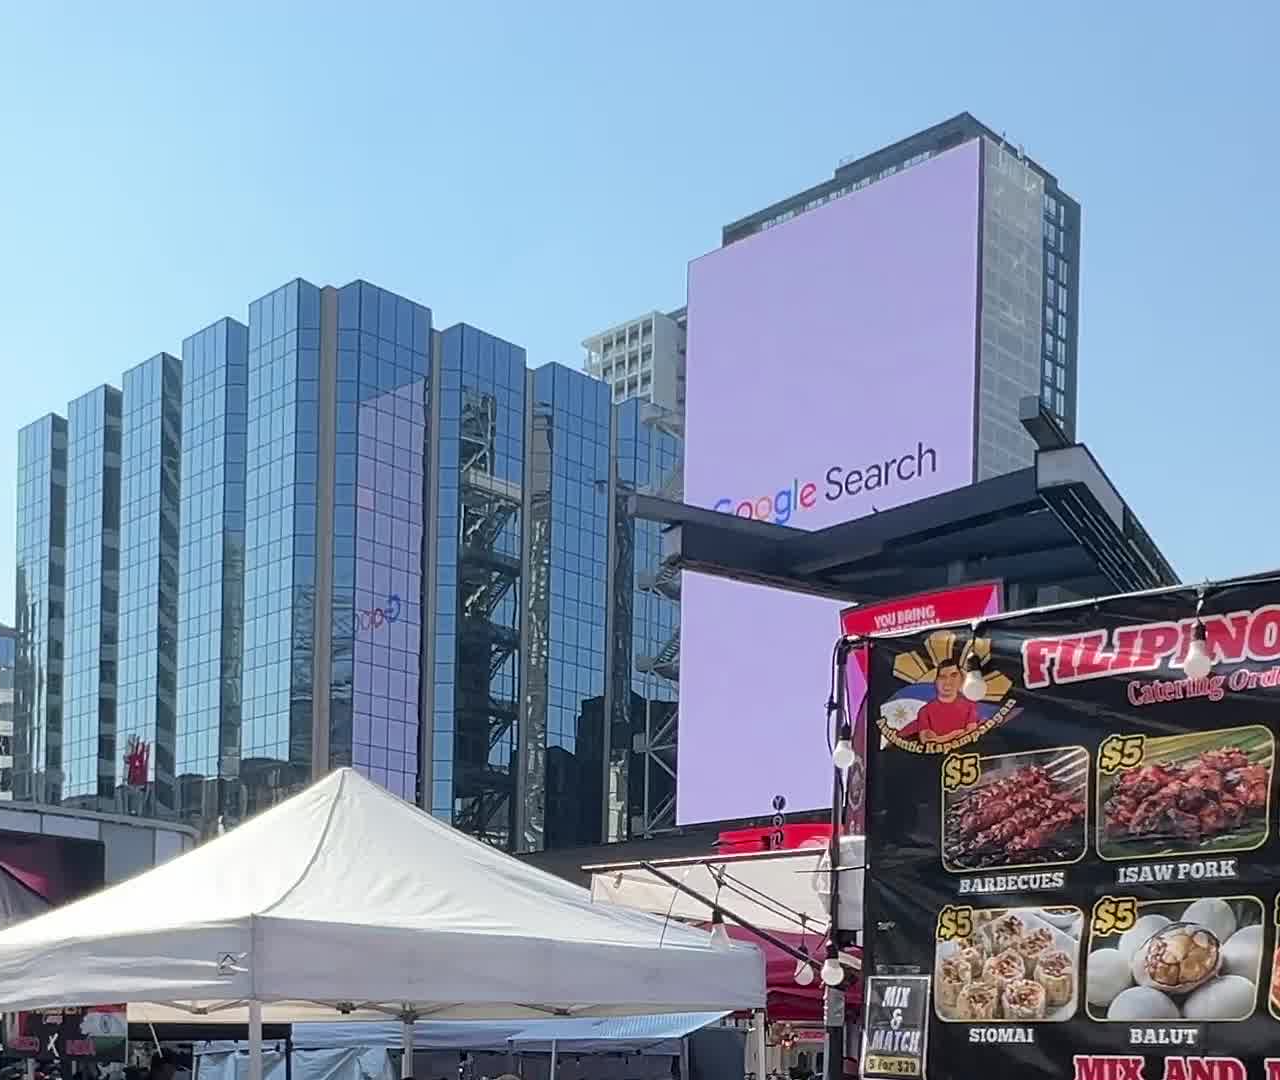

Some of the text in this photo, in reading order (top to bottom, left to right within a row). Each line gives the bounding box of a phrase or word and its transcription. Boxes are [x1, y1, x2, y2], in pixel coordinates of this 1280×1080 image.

[825, 442, 937, 500] Search
[874, 612, 896, 629] YOU
[897, 605, 936, 627] BRING
[1128, 672, 1224, 707] Catering
[1101, 736, 1144, 770] $5
[945, 756, 979, 789] $5
[959, 872, 1065, 894] BARBECUES
[1118, 859, 1236, 885] ISAW PORK
[937, 908, 972, 940] $5
[1093, 899, 1137, 934] $5
[882, 985, 912, 1008] MIX
[872, 1030, 921, 1053] MATCH
[969, 1028, 1035, 1044] SIOMAI
[1130, 1028, 1199, 1045] BALUT
